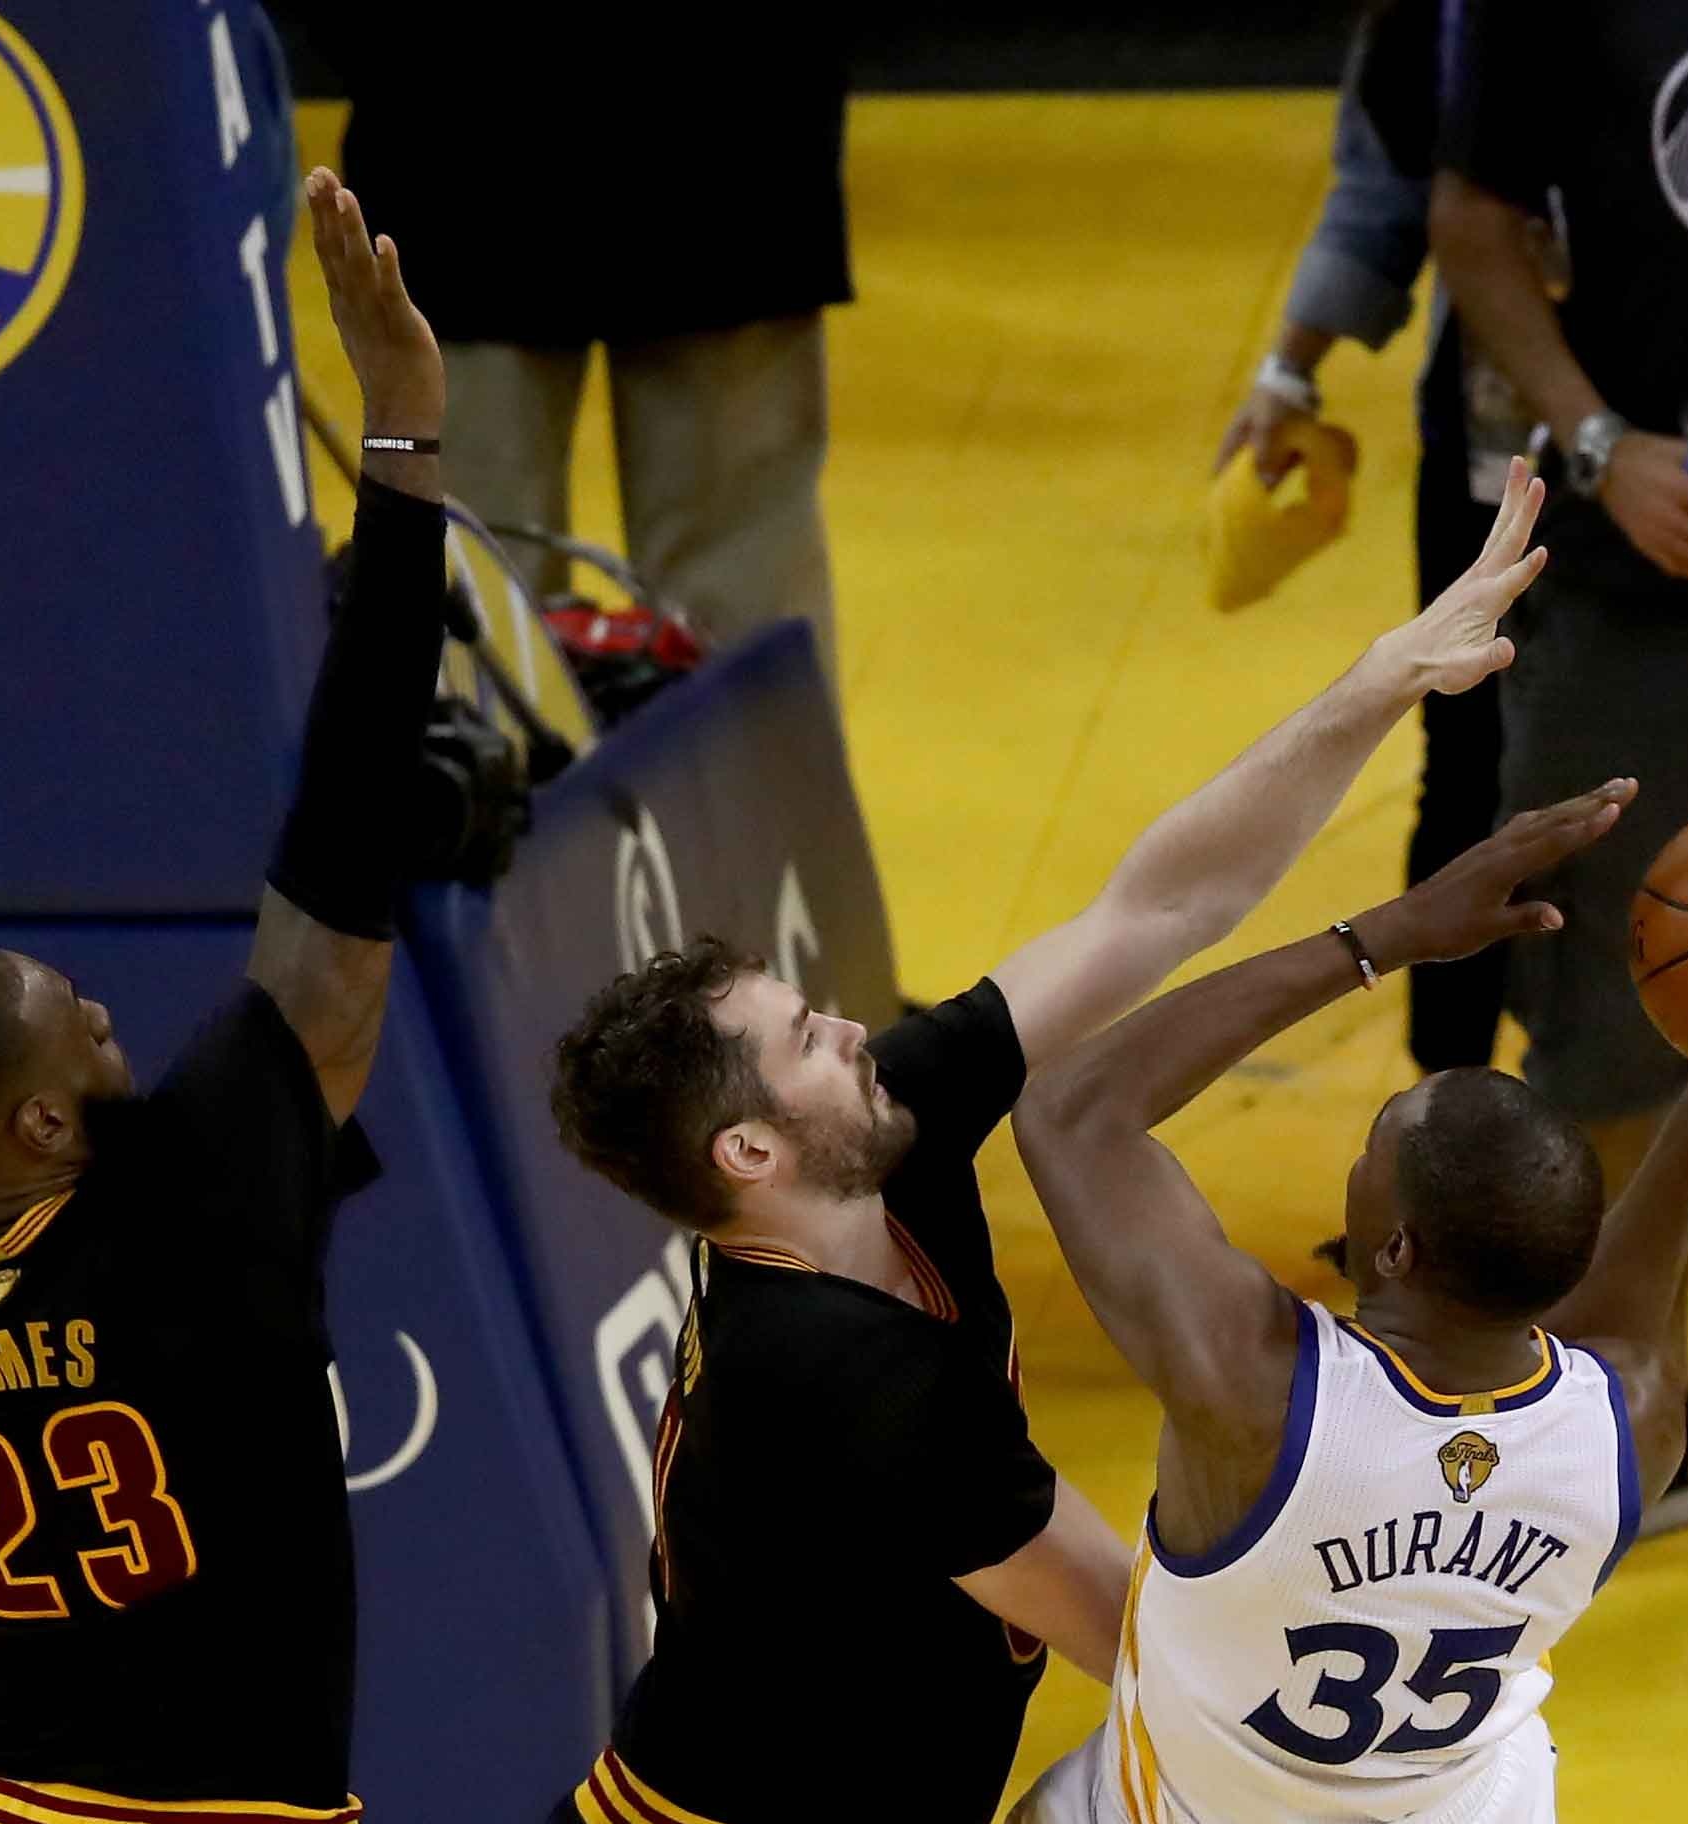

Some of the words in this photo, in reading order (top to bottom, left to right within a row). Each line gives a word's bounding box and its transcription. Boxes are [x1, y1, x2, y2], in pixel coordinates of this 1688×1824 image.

[239, 213, 307, 528] TV
[1312, 1510, 1570, 1595] DURANT
[1240, 1614, 1531, 1766] 35
